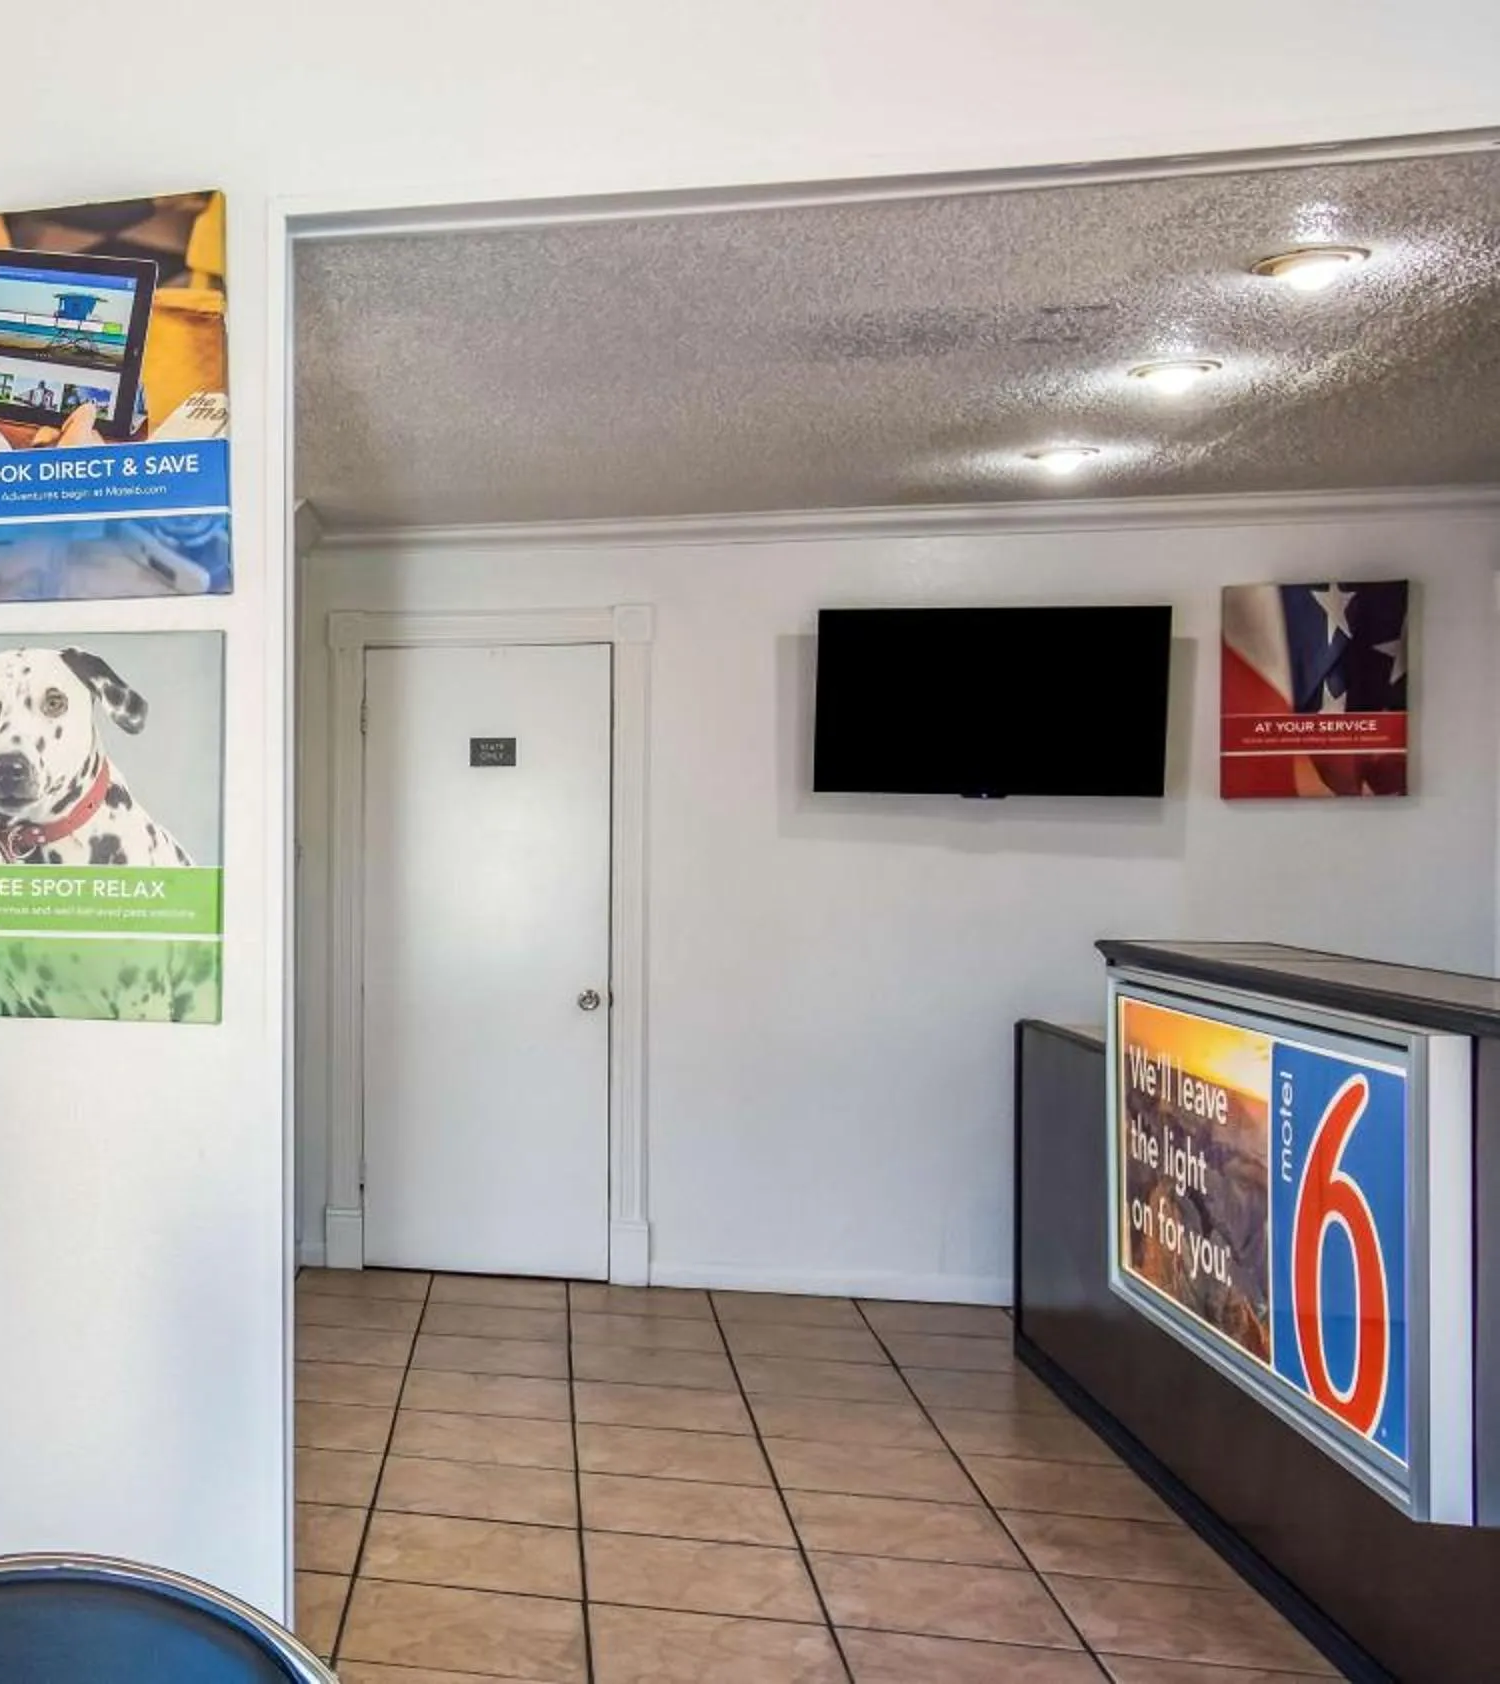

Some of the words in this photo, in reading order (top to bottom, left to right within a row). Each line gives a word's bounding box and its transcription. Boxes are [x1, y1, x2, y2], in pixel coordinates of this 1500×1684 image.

[39, 459, 116, 481] DIRECT
[122, 457, 138, 477] &
[145, 453, 199, 475] SAVE
[1254, 721, 1273, 733] AT
[1275, 720, 1315, 733] YOUR
[1318, 719, 1378, 732] SERVICE
[30, 878, 87, 898] SPOT
[92, 879, 166, 899] RELAX
[1129, 1044, 1172, 1103] We'll
[1177, 1063, 1229, 1125] leave
[1131, 1113, 1159, 1169] the
[1162, 1125, 1208, 1197] light
[1132, 1197, 1153, 1238] on
[1157, 1196, 1185, 1255] for
[1279, 1070, 1293, 1183] motel
[1291, 1073, 1391, 1439] 6
